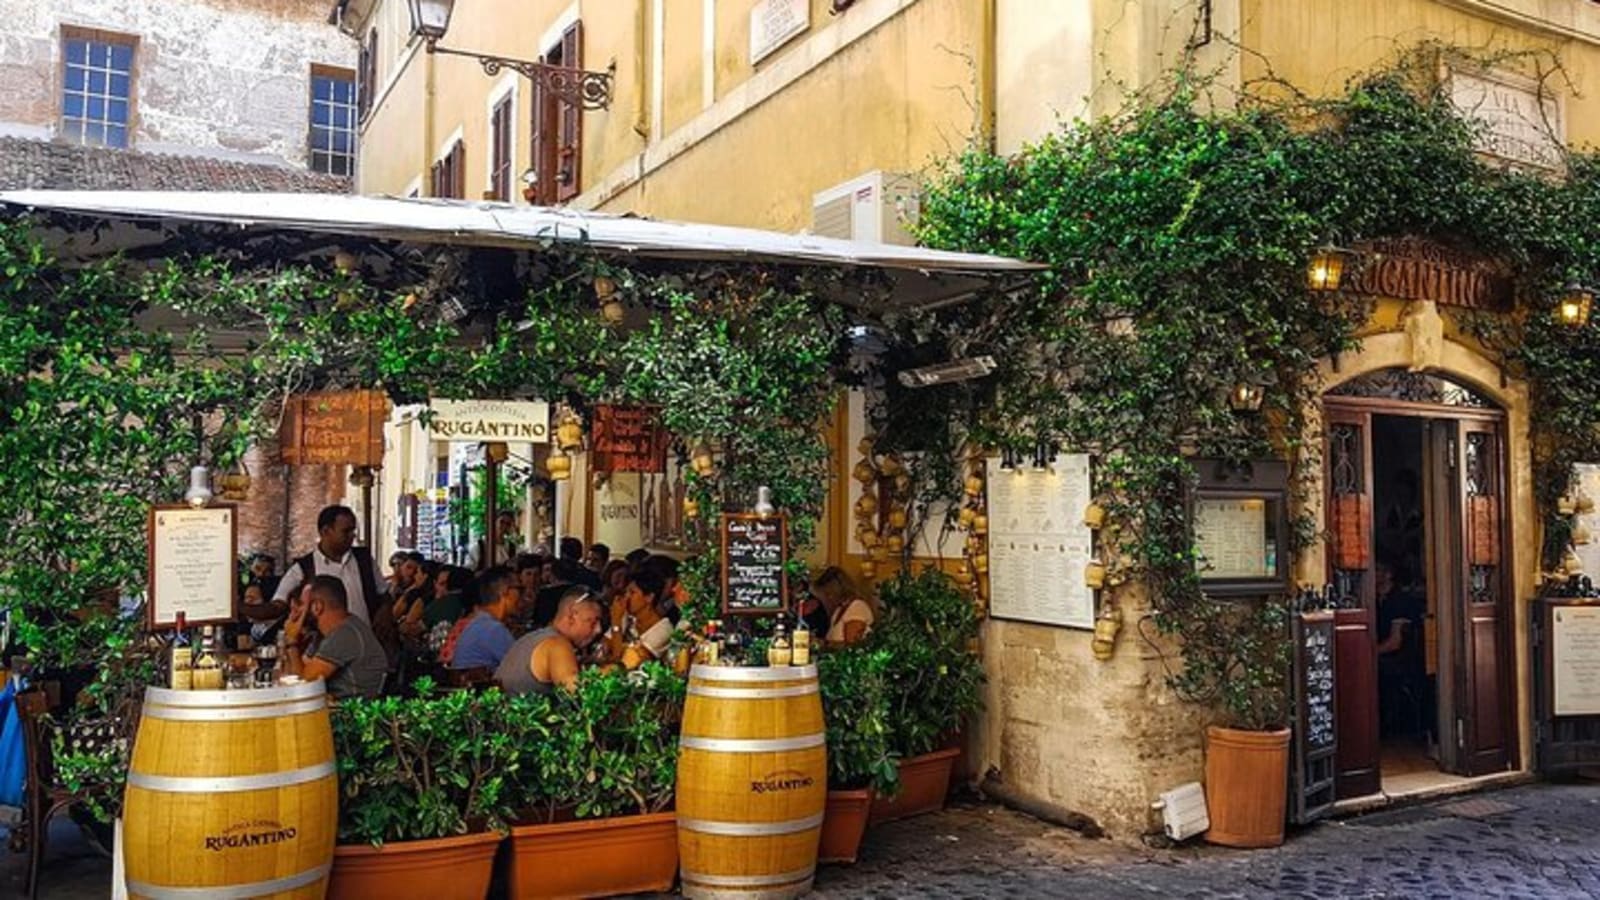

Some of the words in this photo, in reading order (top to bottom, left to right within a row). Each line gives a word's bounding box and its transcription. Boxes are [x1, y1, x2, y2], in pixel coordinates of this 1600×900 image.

[433, 419, 545, 438] RUGANTINO
[750, 777, 814, 793] RUGANTINO
[205, 827, 296, 851] RUGANTINO
